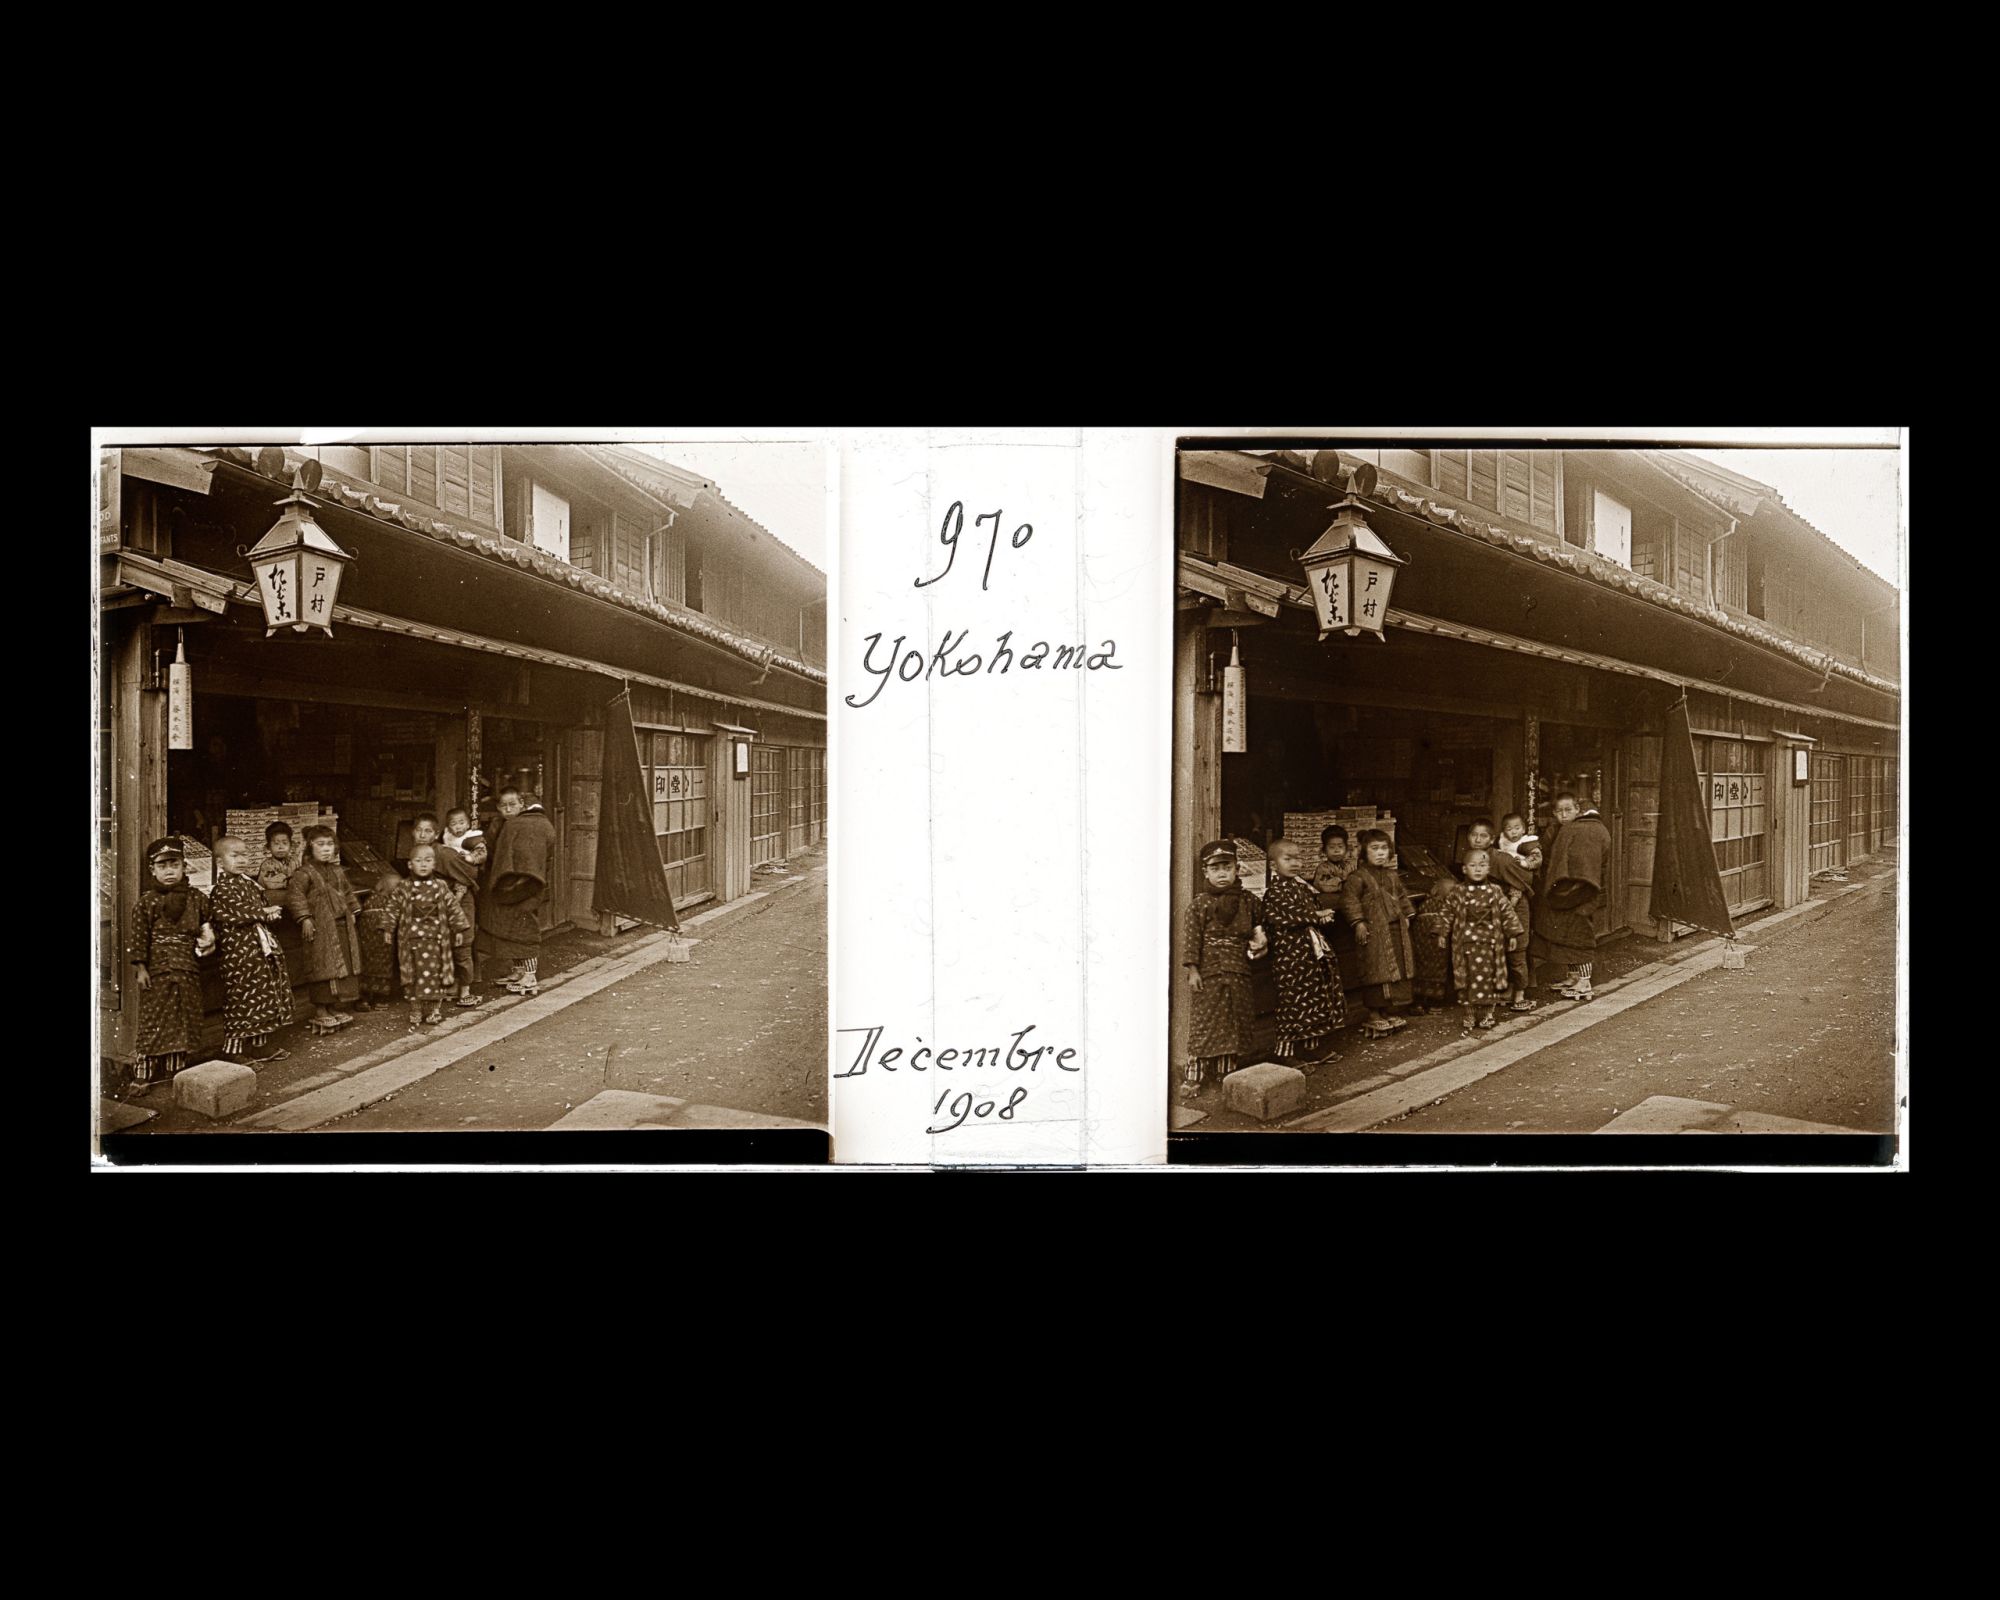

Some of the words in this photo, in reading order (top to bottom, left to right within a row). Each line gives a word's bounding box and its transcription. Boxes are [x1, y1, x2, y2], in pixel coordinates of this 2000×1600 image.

[914, 500, 1033, 590] 970
[310, 567, 326, 614] 戸村
[1363, 571, 1378, 618] 戸村
[926, 1086, 1028, 1134] 1908
